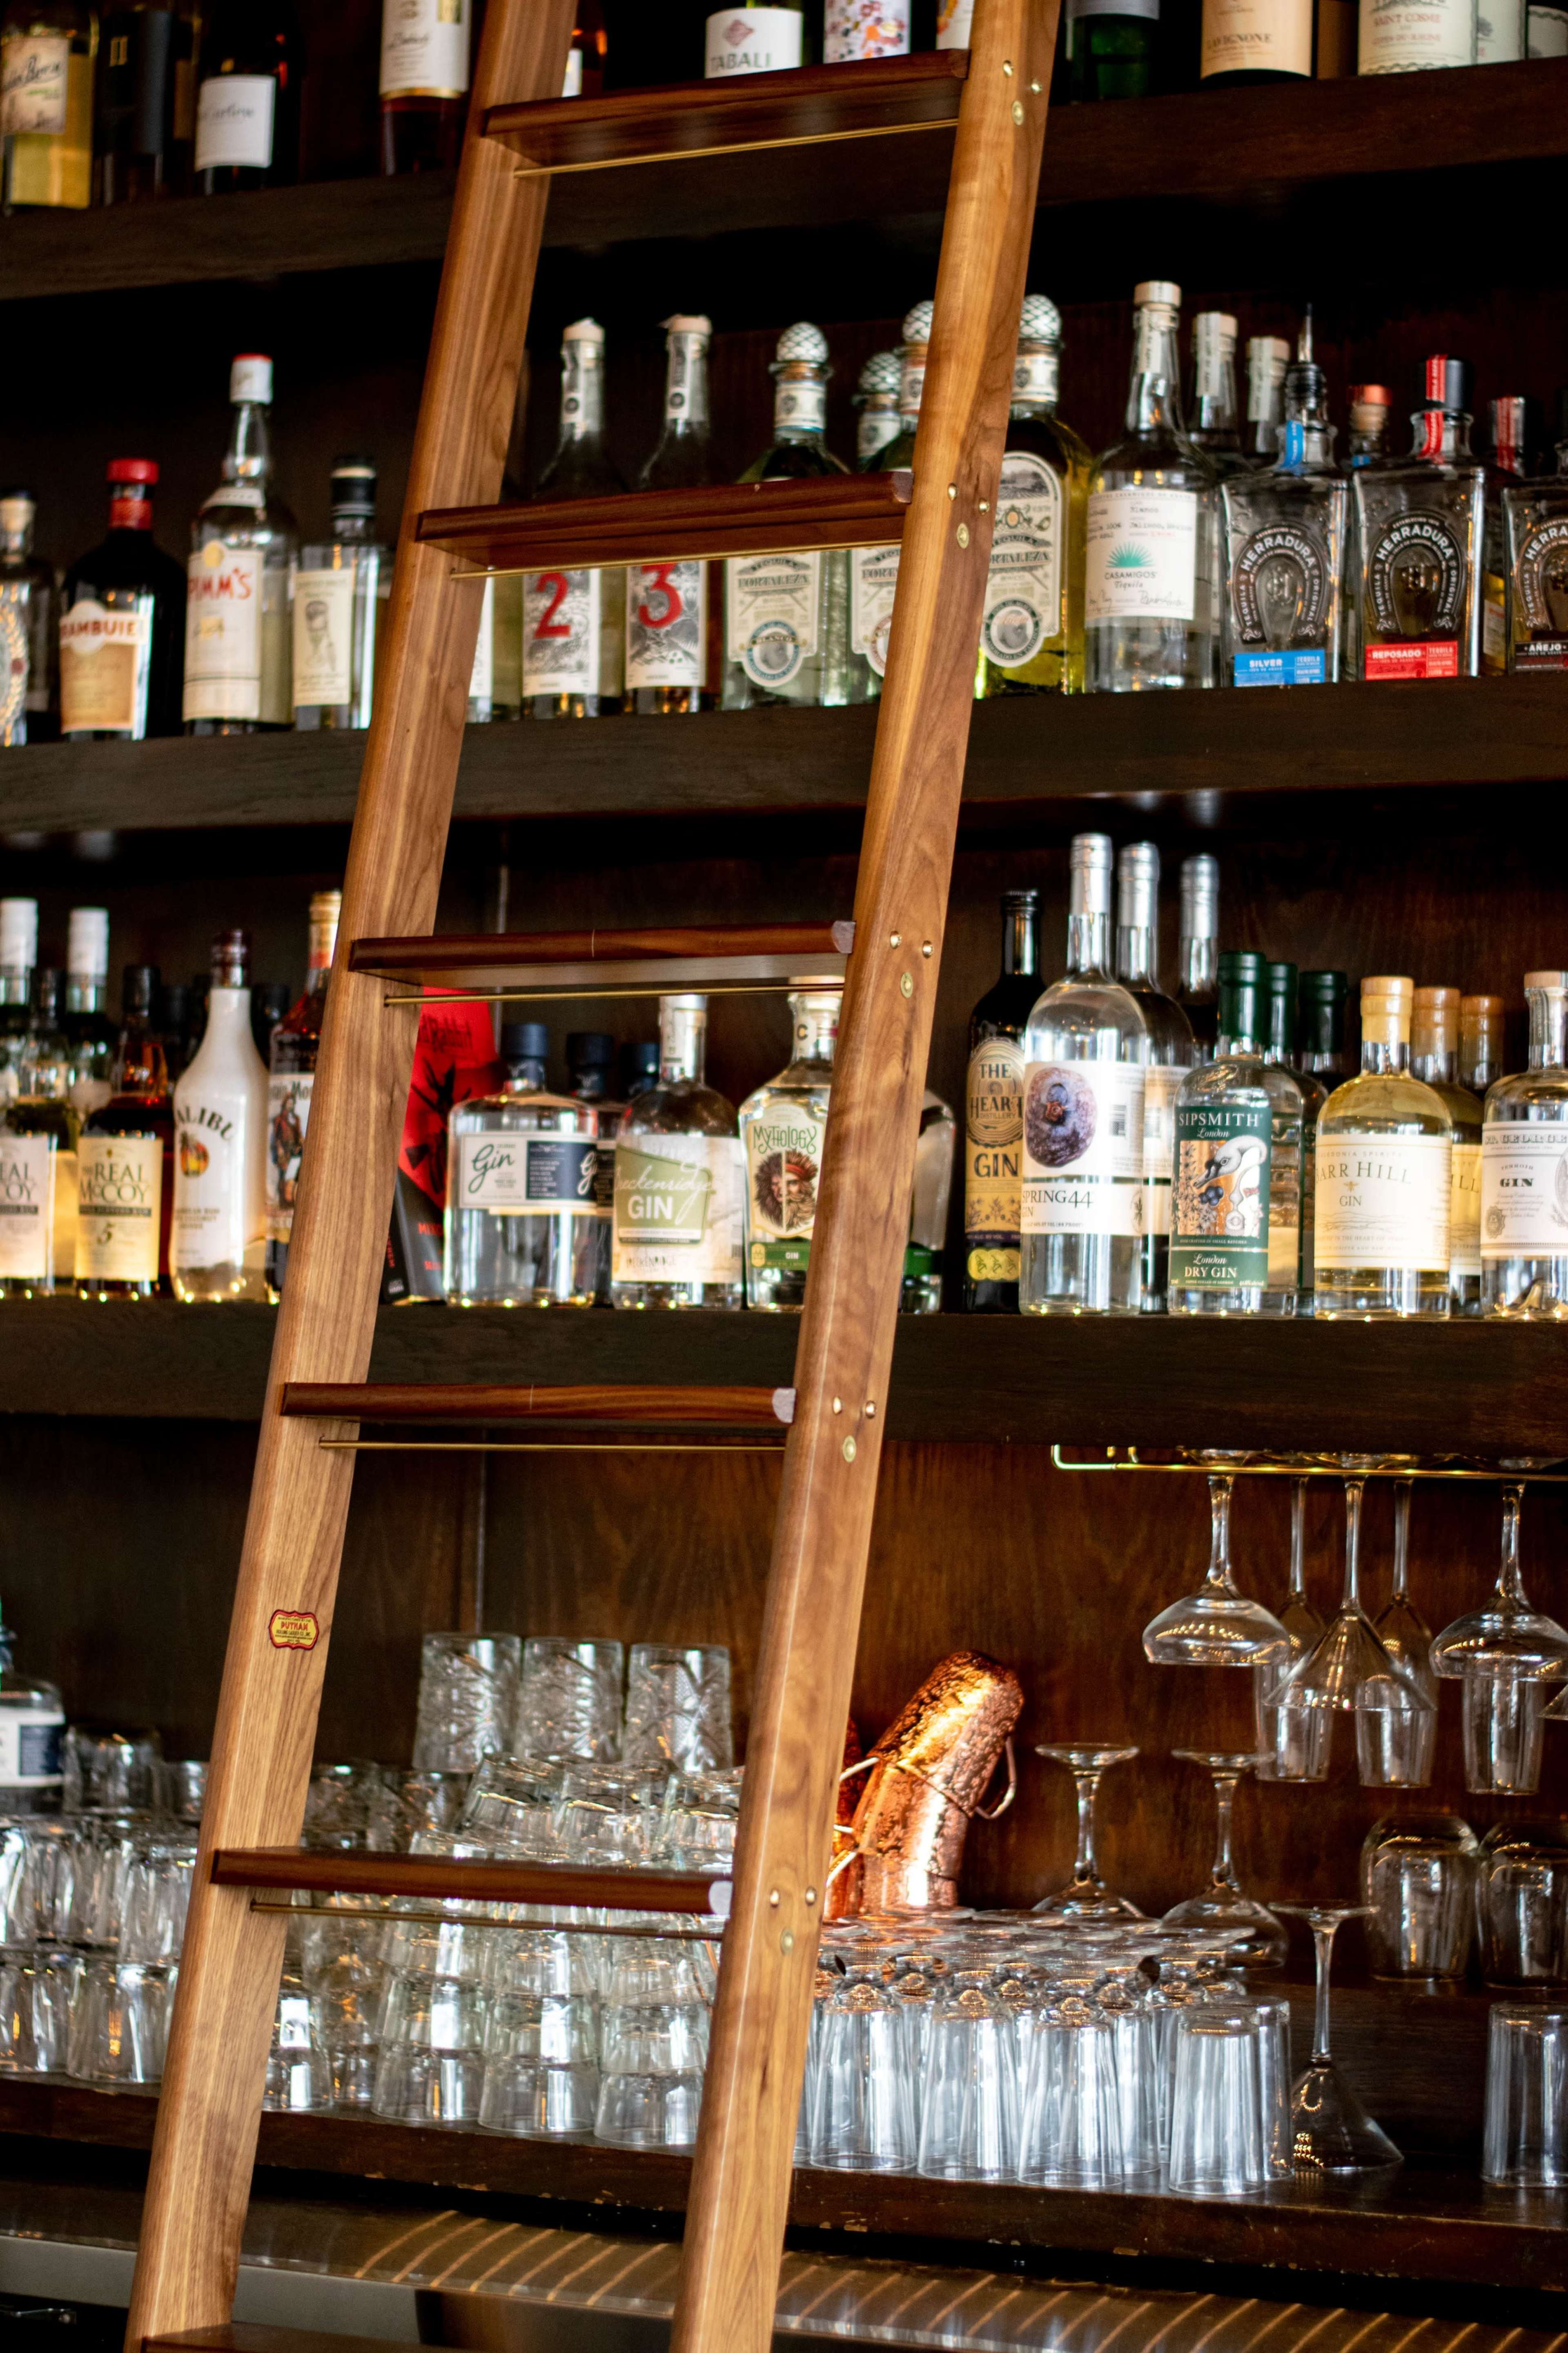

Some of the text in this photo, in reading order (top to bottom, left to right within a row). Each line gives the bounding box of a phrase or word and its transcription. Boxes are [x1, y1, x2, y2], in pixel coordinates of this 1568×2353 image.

[1240, 535, 1316, 571] HERRADURA
[1376, 524, 1454, 561] HERRADURA
[1524, 525, 1568, 560] HERRA
[1105, 571, 1156, 580] CASAMIGOS
[1114, 580, 1143, 590] Tequila
[638, 563, 683, 629] 3
[1307, 578, 1320, 621] ORIGINAL
[1374, 573, 1386, 616] TEQUILA
[1443, 570, 1458, 613] ORIGINAL
[1523, 573, 1535, 613] TEQUILA
[532, 571, 571, 640] 2
[1239, 584, 1252, 626] TEQUILA
[1372, 649, 1422, 660] REPOSADO
[1528, 642, 1562, 653] AÑEJO
[1249, 658, 1283, 668] SILVER
[980, 1063, 1012, 1079] THE
[970, 1095, 1024, 1119] HEART
[1179, 1112, 1259, 1127] SIPSMITH
[1196, 1127, 1230, 1139] London
[94, 1163, 144, 1182] REAL
[468, 1144, 515, 1194] Gin
[973, 1152, 1019, 1178] GIN
[1357, 1161, 1412, 1184] HILL
[613, 1162, 712, 1225] reckenridge
[1499, 1178, 1534, 1188] GIN
[628, 1195, 674, 1220] GIN
[1339, 1195, 1362, 1207] GIN
[1193, 1253, 1227, 1265] London
[1184, 1267, 1238, 1278] DRY GIN
